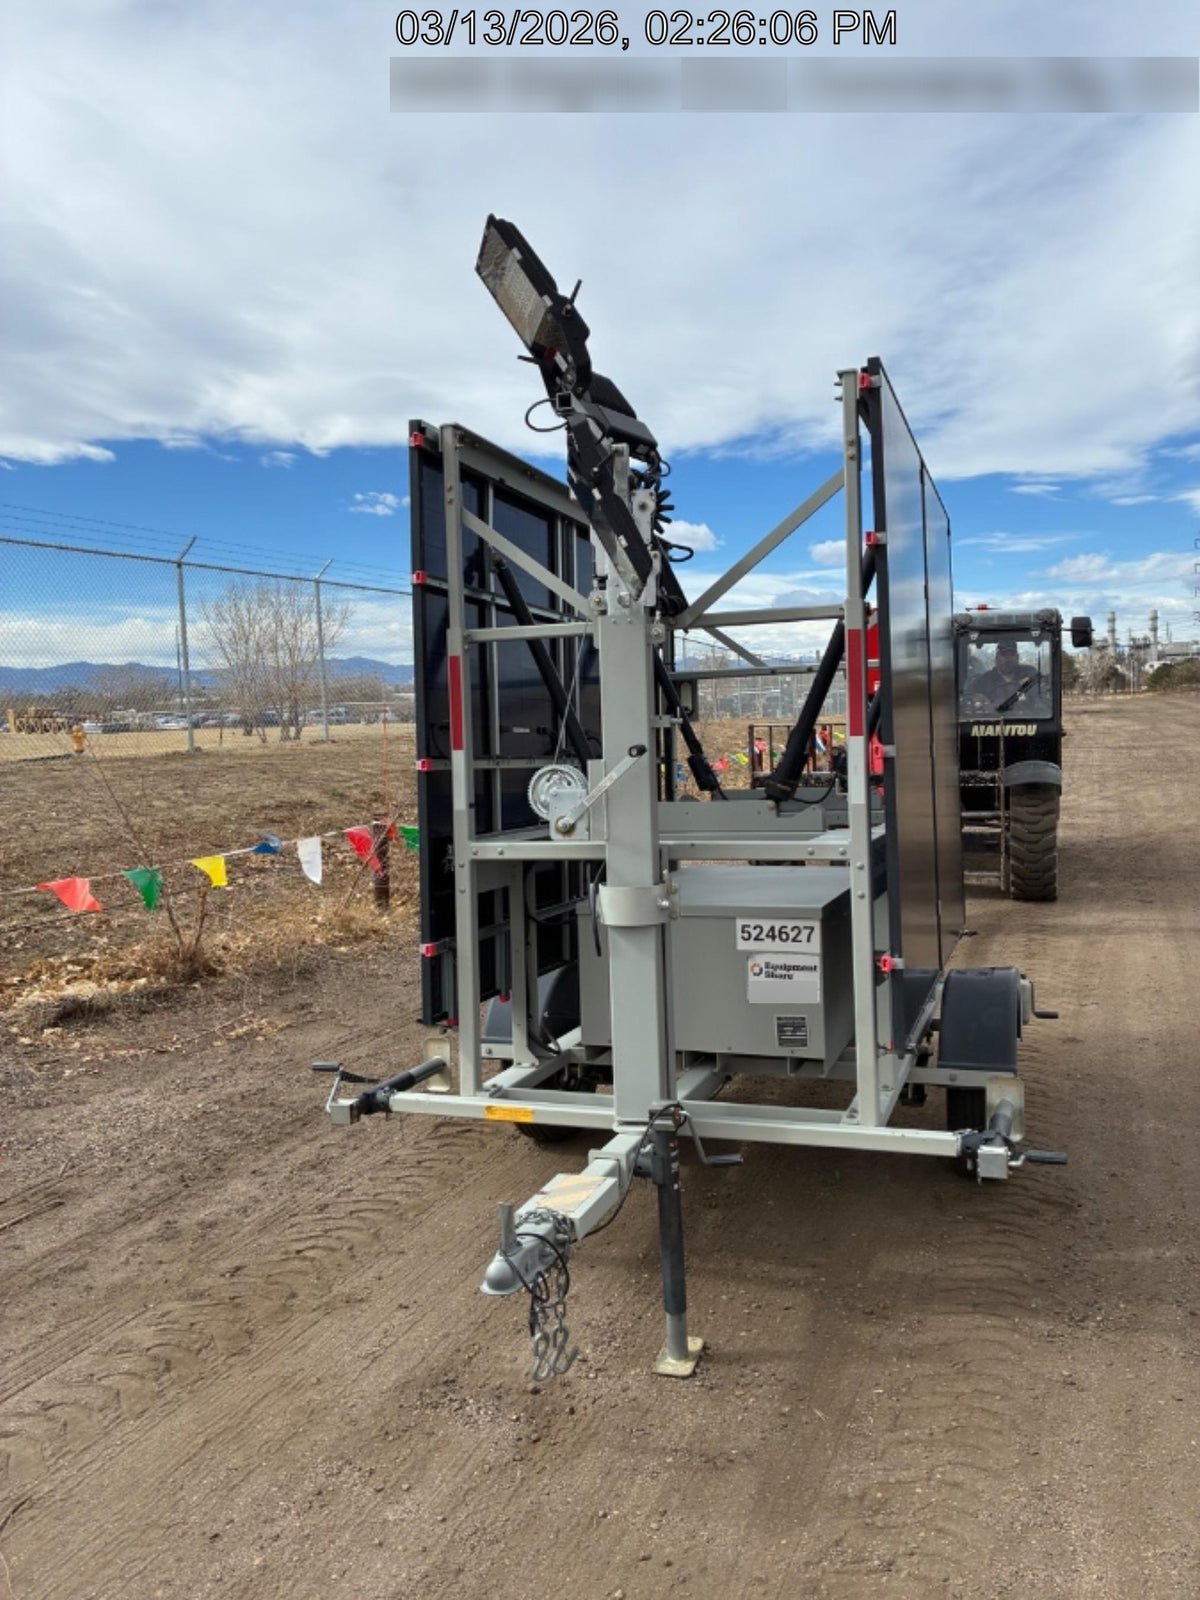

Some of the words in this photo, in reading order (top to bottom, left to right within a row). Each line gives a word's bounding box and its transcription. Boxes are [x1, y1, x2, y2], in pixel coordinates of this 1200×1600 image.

[971, 724, 1037, 737] MANITOU
[741, 924, 815, 943] 524627
[764, 961, 817, 972] Equipment
[764, 971, 794, 980] Share
